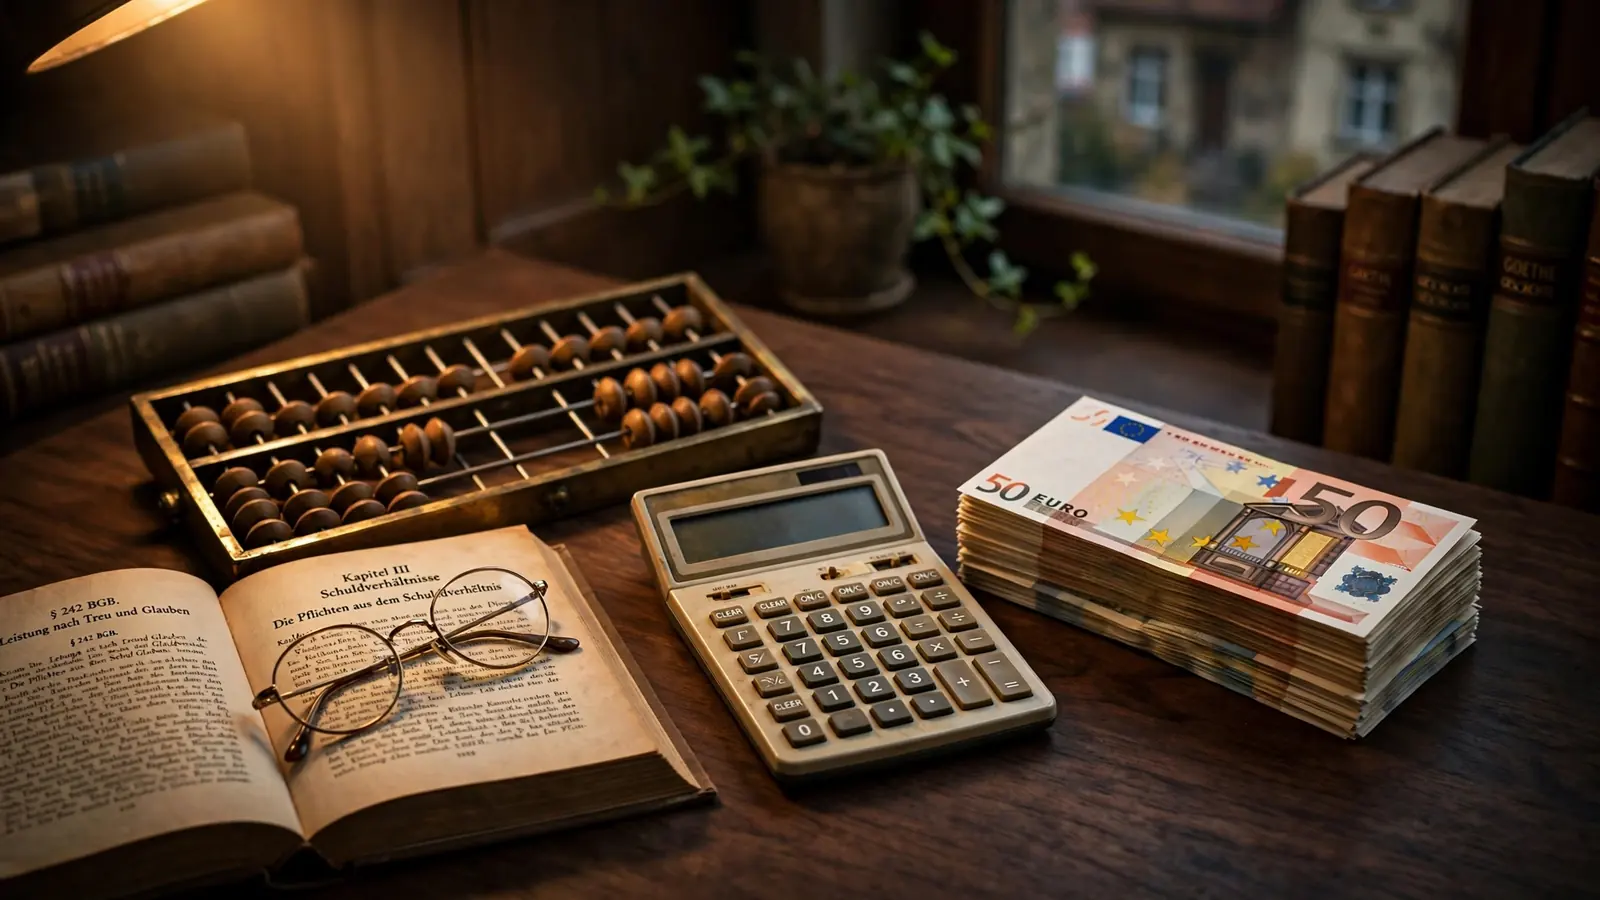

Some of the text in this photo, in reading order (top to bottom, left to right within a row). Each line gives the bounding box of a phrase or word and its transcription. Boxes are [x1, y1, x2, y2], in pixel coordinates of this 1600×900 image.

[975, 473, 1030, 502] 50
[1032, 493, 1088, 518] EURO
[1297, 482, 1402, 540] 50
[342, 564, 410, 582] Kapitel III
[913, 571, 937, 581] ON/C
[320, 574, 440, 599] Schuldverhältnisse
[876, 578, 900, 588] ON/C
[838, 585, 863, 595] ON/C
[800, 592, 825, 602] ON/C
[61, 604, 83, 616] 242
[87, 597, 119, 609] BGB.
[760, 600, 788, 611] CLEAR
[859, 605, 872, 615] 9
[273, 618, 294, 629] Die
[297, 605, 349, 622] Pflichten
[353, 601, 372, 611] aus
[376, 596, 400, 606] dem
[716, 608, 743, 619] CLEAR
[821, 613, 833, 623] 8
[0, 605, 190, 646] Leistung nach Treu und Glauben
[781, 620, 791, 631] 7
[876, 627, 888, 637] 6
[78, 635, 94, 644] 242
[836, 635, 849, 645] 5
[795, 642, 806, 654] 7
[892, 650, 905, 660] 6
[852, 657, 865, 668] 5
[813, 666, 824, 676] 4
[908, 672, 921, 683] 3
[868, 681, 882, 692] 2
[828, 690, 838, 700] 1
[798, 724, 811, 736] 0
